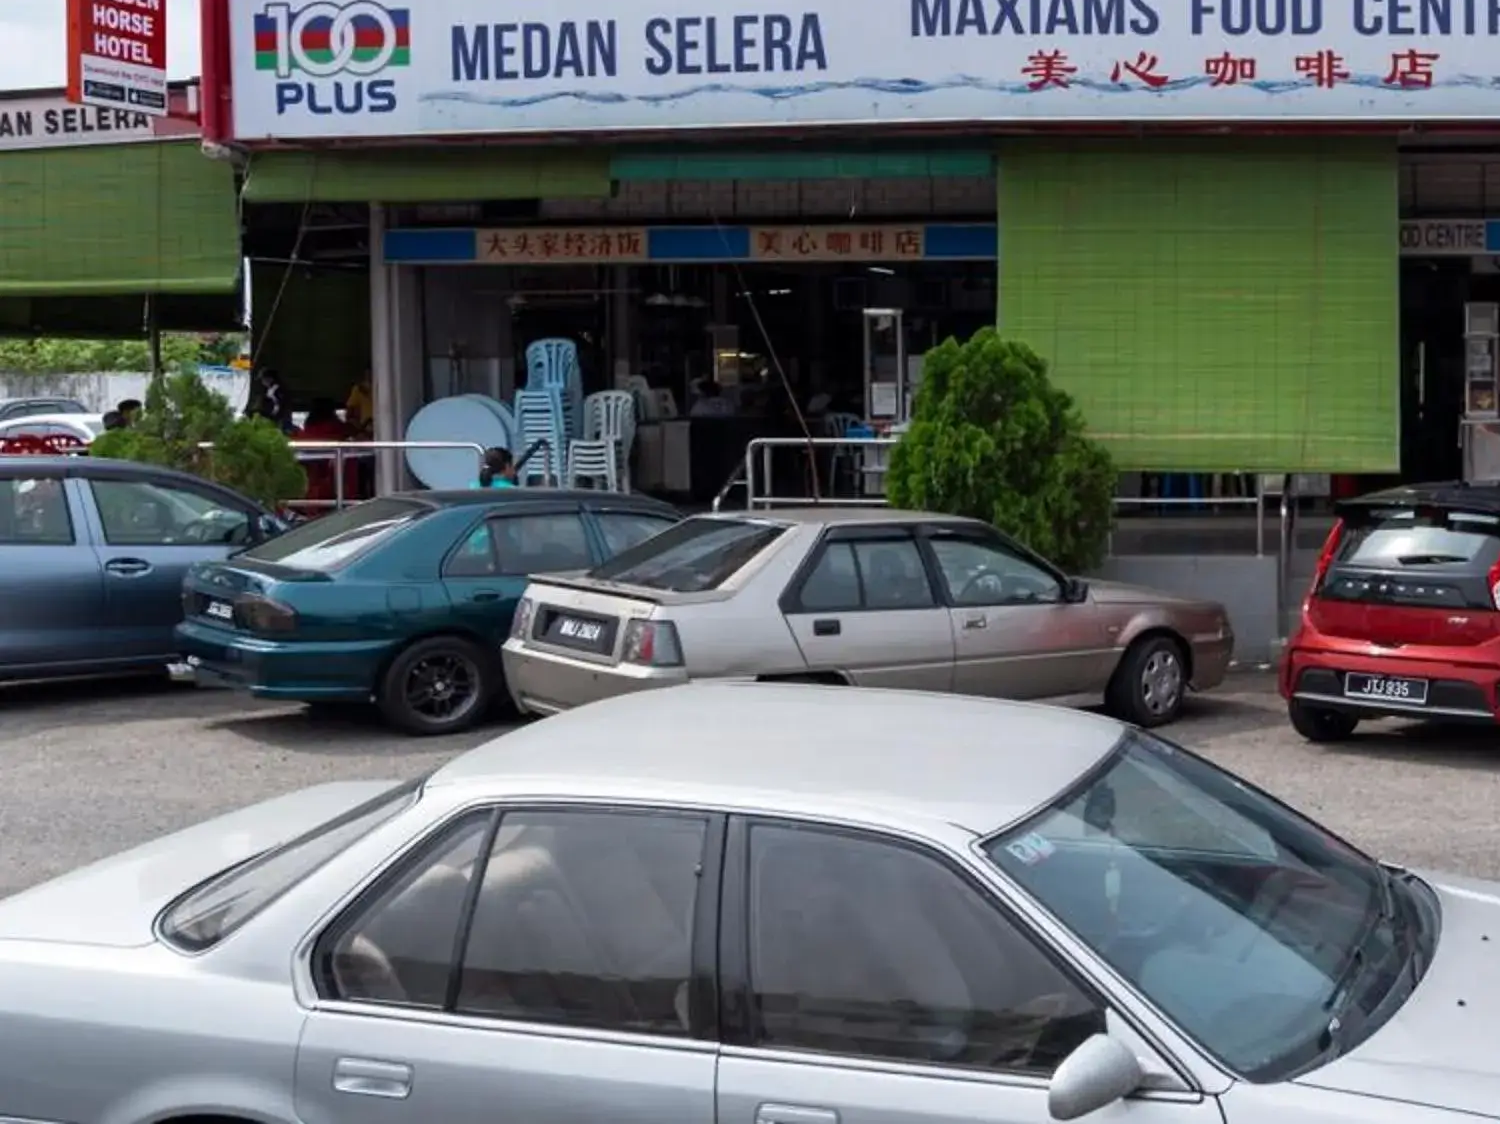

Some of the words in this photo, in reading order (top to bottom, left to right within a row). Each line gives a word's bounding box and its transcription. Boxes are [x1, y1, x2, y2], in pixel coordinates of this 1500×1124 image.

[93, 3, 153, 37] HORSE
[94, 33, 153, 65] HOTEL
[265, 0, 397, 78] 100
[451, 20, 617, 82] MEDAN
[645, 13, 828, 76] SELERA
[1021, 48, 1440, 91] 美心咖啡店
[276, 79, 397, 115] PLUS
[44, 106, 149, 134] SELERA
[1425, 223, 1485, 248] CENTRE
